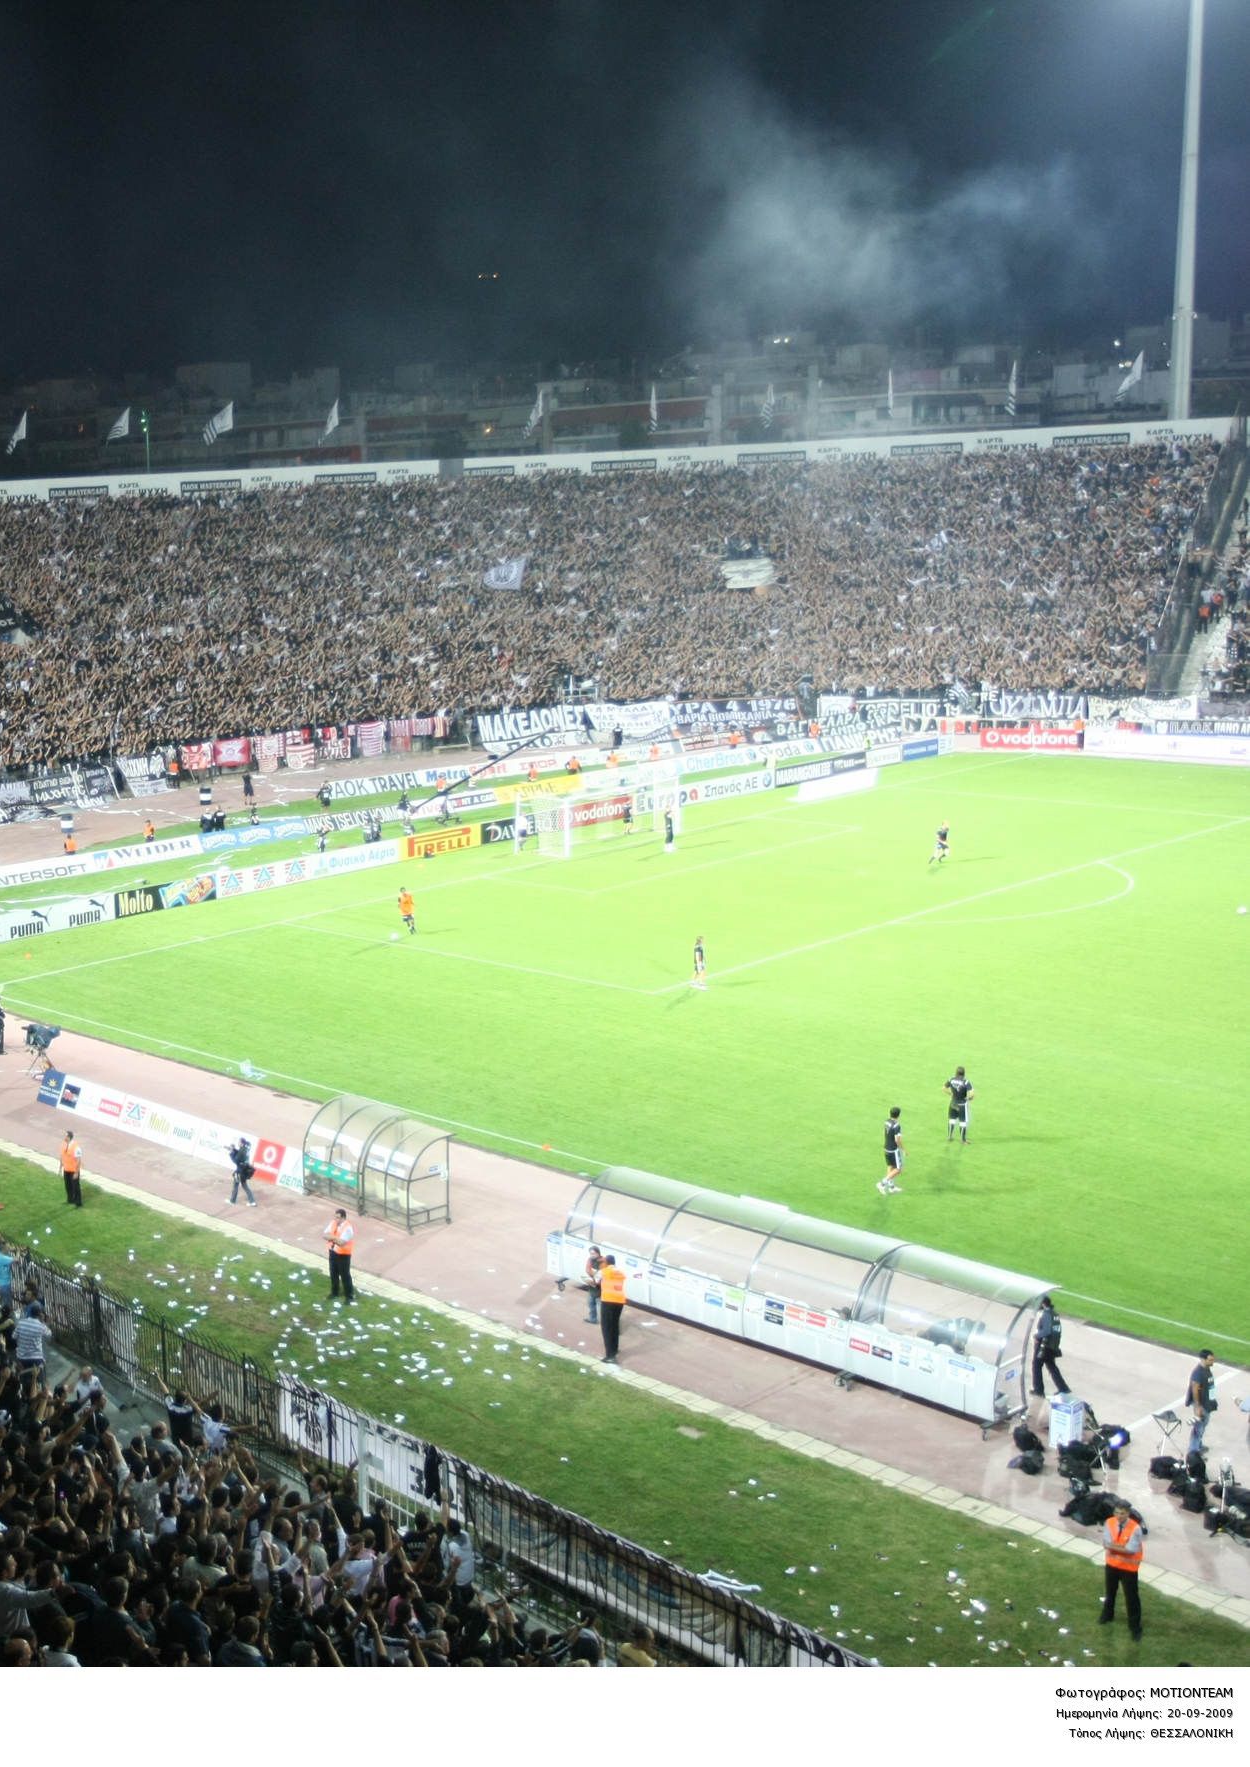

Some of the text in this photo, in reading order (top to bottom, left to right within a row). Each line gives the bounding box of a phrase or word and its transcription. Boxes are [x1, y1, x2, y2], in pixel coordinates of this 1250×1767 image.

[727, 700, 739, 711] 4
[477, 705, 587, 741] ΜΑΚΕΔΟΝΕΣ
[1002, 731, 1077, 745] vodafone
[333, 772, 422, 799] AOK TRAVEL
[704, 777, 758, 798] Σπανός ΑΕ
[304, 814, 334, 834] MAKIS
[335, 810, 370, 830] TSELIOS
[371, 807, 402, 824] HOMM
[574, 803, 627, 822] vodafon
[408, 826, 471, 858] PIRELLI
[329, 845, 396, 868] Φυσικό Αέριο
[118, 889, 153, 917] Molto
[69, 910, 101, 927] PUMA
[10, 921, 44, 939] PUMA
